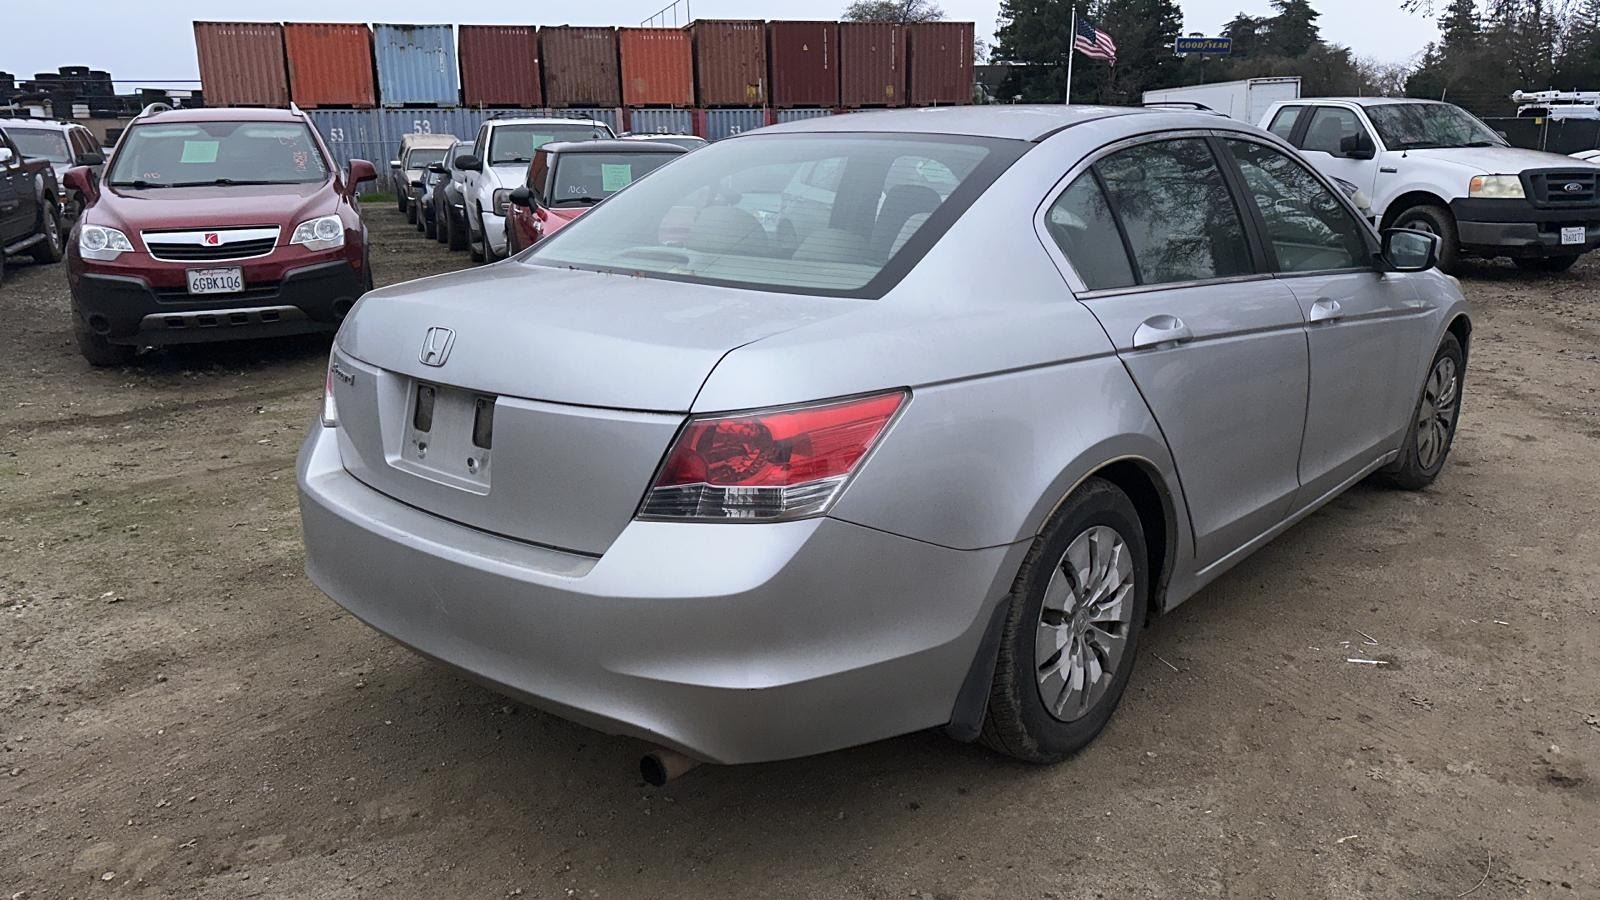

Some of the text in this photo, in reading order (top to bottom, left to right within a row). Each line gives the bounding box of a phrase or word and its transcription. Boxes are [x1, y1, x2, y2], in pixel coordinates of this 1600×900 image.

[1179, 40, 1229, 50] GOODYEAR
[413, 120, 431, 134] 53
[331, 128, 344, 142] 53
[192, 276, 241, 290] 6GBK106
